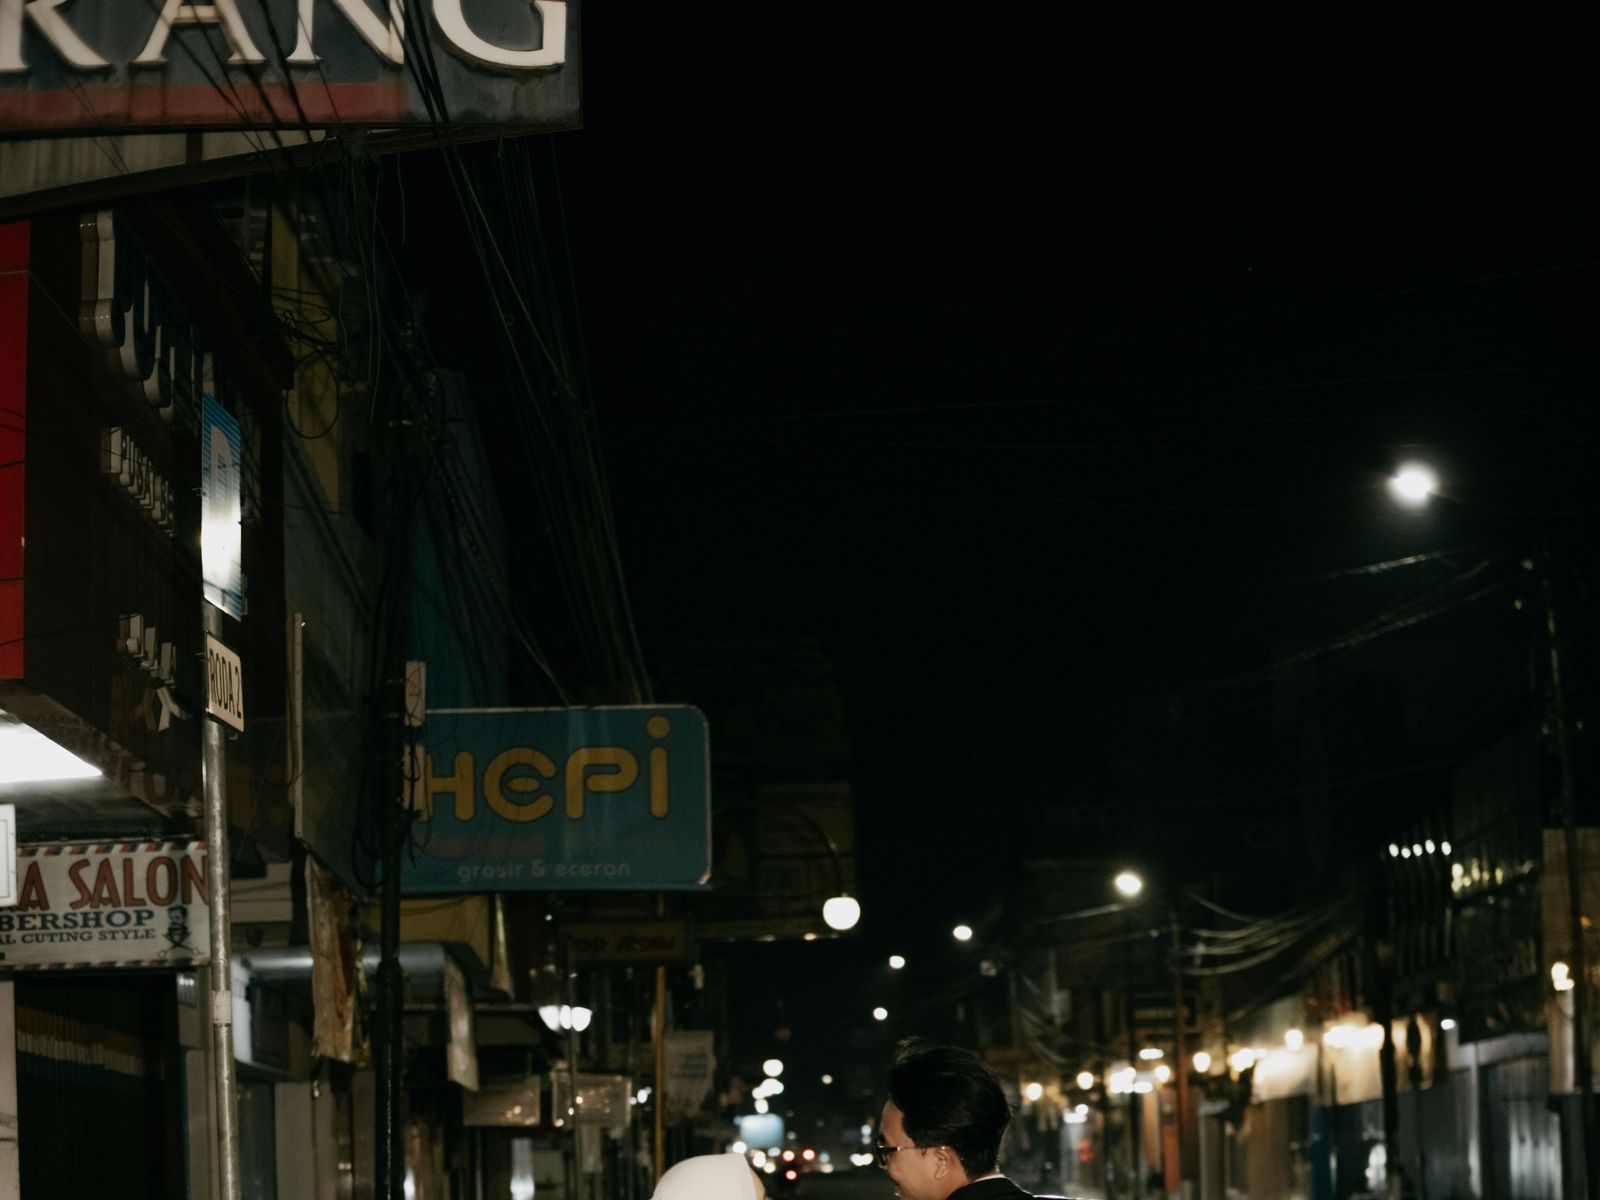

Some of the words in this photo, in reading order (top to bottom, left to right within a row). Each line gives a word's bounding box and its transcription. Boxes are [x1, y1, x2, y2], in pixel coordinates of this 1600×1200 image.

[209, 648, 236, 716] RODA
[234, 666, 242, 719] 2
[16, 860, 50, 911] A
[68, 855, 210, 910] SALON
[457, 861, 524, 883] grosir
[531, 859, 547, 877] &
[21, 931, 93, 944] CUTING
[99, 928, 156, 941] STYLE
